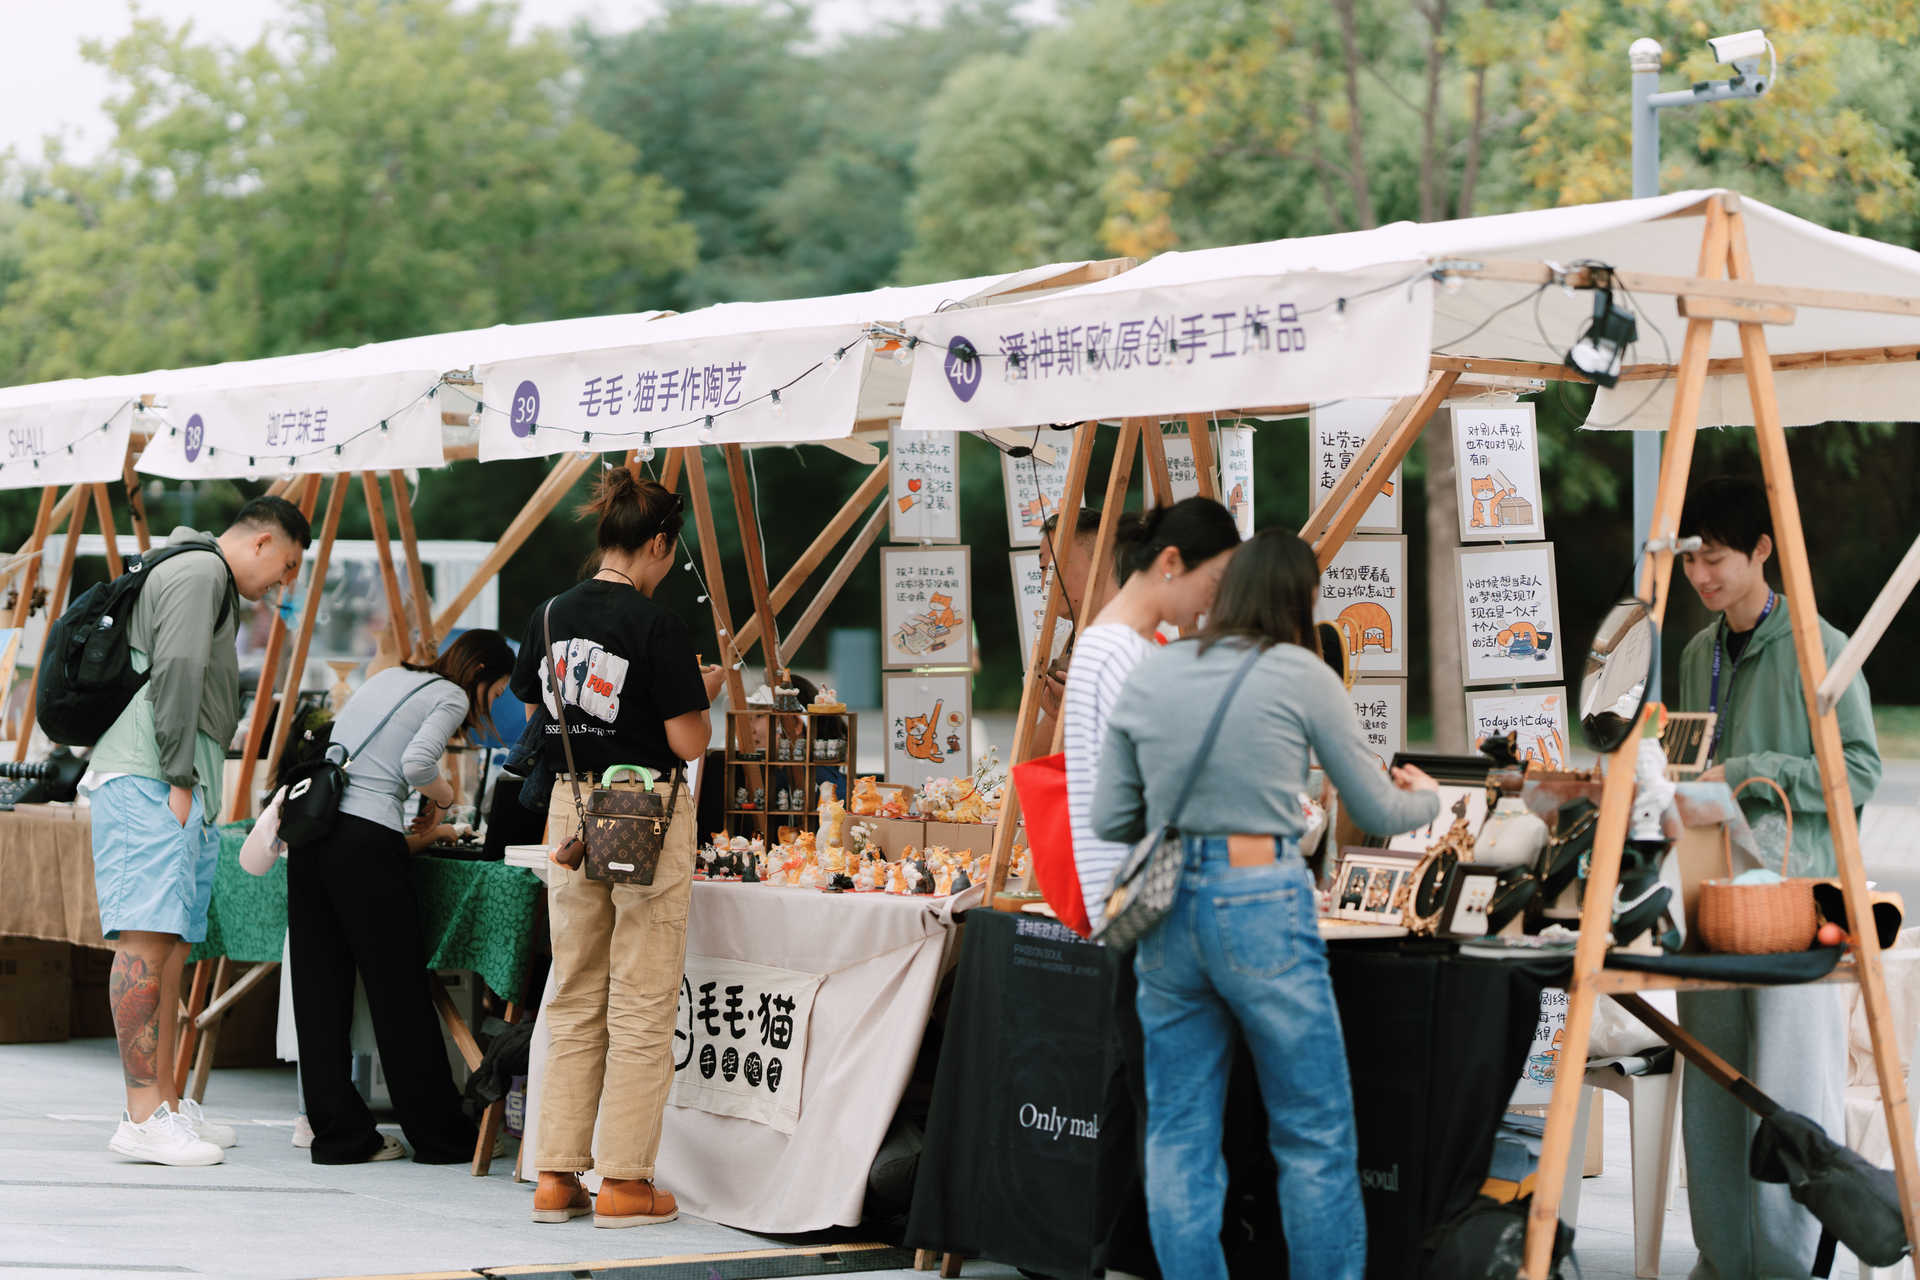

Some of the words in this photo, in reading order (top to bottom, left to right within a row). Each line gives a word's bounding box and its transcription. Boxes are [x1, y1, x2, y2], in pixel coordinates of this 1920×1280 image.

[949, 350, 977, 386] 40
[578, 361, 747, 418] 毛毛·猫手作陶艺
[515, 396, 536, 424] 39
[265, 408, 329, 448] 迦宁珠宝
[1467, 422, 1522, 438] 对别人再好
[185, 424, 203, 452] 38
[1466, 439, 1526, 452] 也不如对别人
[1469, 453, 1489, 467] 有用
[1326, 565, 1391, 583] 我倒要看看
[1466, 574, 1542, 589] 小时候想当超人
[1321, 584, 1396, 599] 这日子你怎么过
[1471, 605, 1539, 619] 现在是一个人干
[1472, 622, 1498, 633] 十个人
[586, 674, 614, 698] FOG
[1479, 714, 1509, 730] Today
[1510, 716, 1518, 726] is
[696, 981, 797, 1050] 毛毛·猫
[1018, 1102, 1068, 1141] Only
